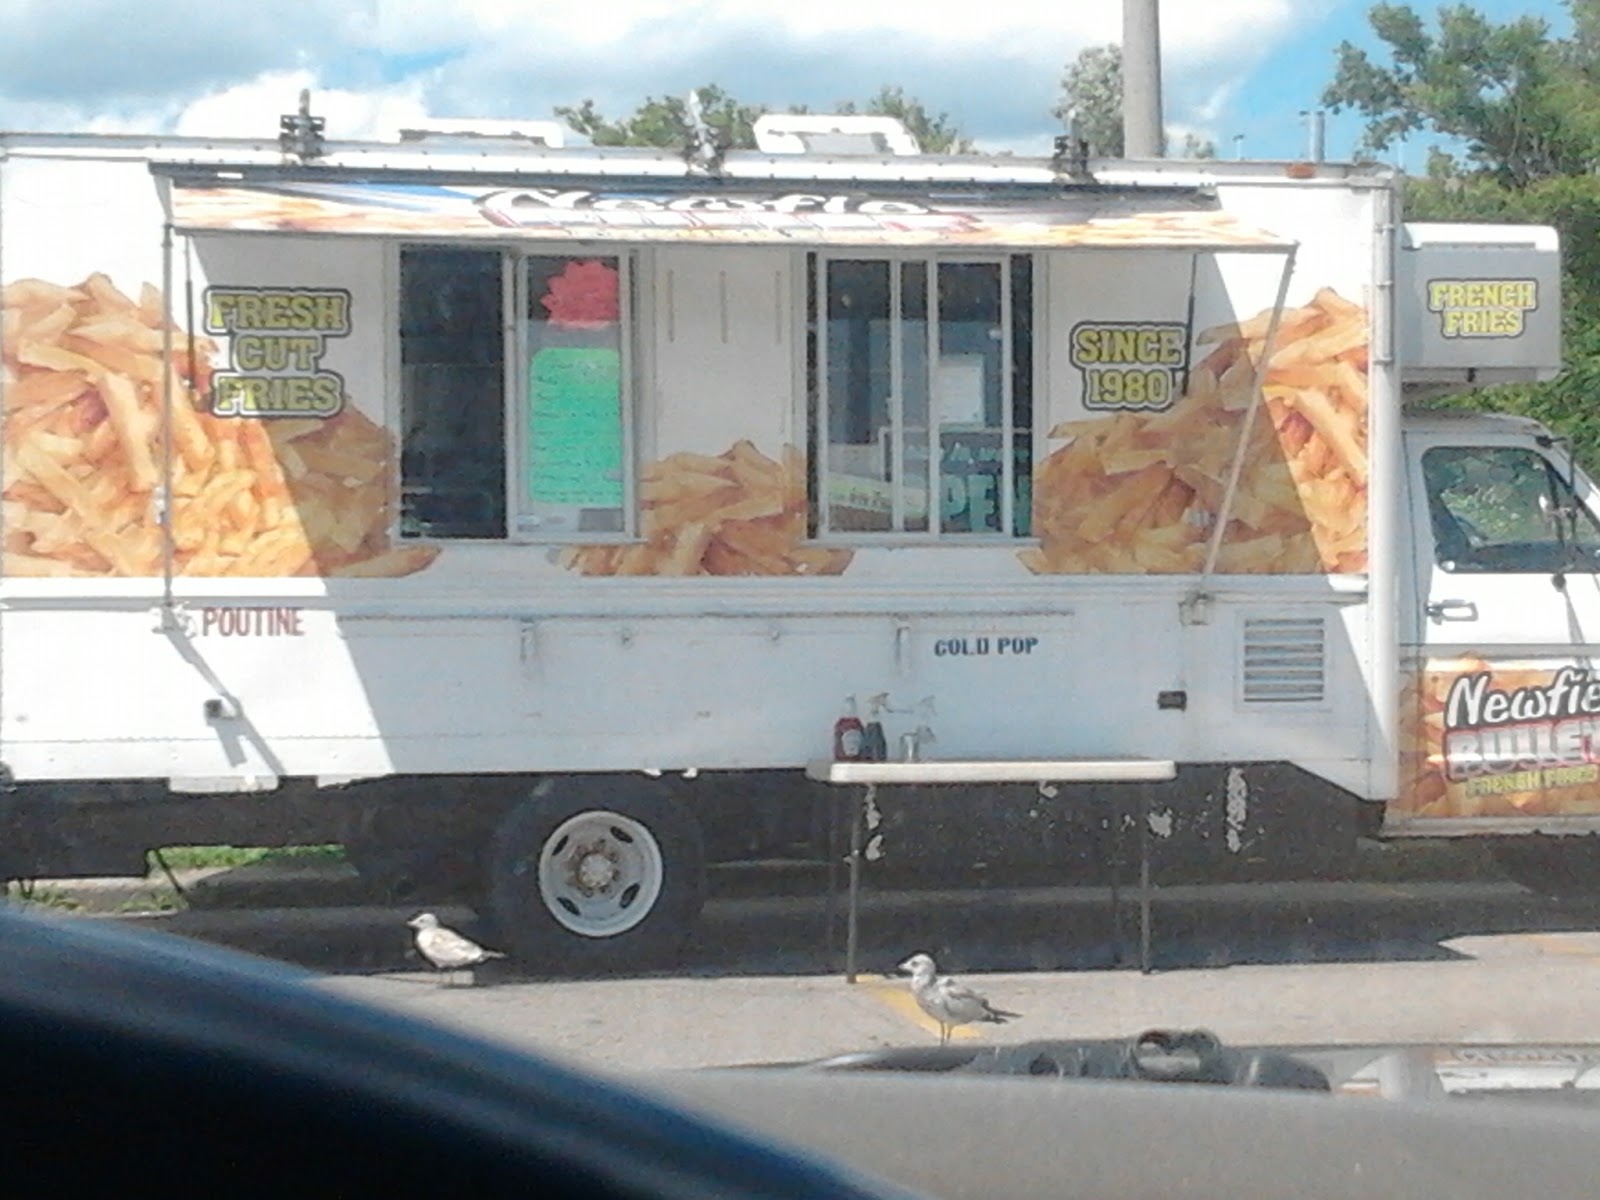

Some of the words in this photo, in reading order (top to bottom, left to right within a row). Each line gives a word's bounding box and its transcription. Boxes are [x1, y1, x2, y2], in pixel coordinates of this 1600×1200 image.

[208, 292, 347, 331] FRESH
[1430, 282, 1535, 308] FRENCH
[1445, 309, 1521, 334] FRIES
[236, 335, 318, 372] CUT
[1076, 328, 1182, 364] SINCE
[216, 374, 340, 411] FRIES
[1088, 368, 1169, 404] 1980
[202, 606, 305, 637] POUTINE
[934, 637, 990, 657] COLD
[997, 636, 1039, 656] POP
[1445, 667, 1600, 728] Newfie
